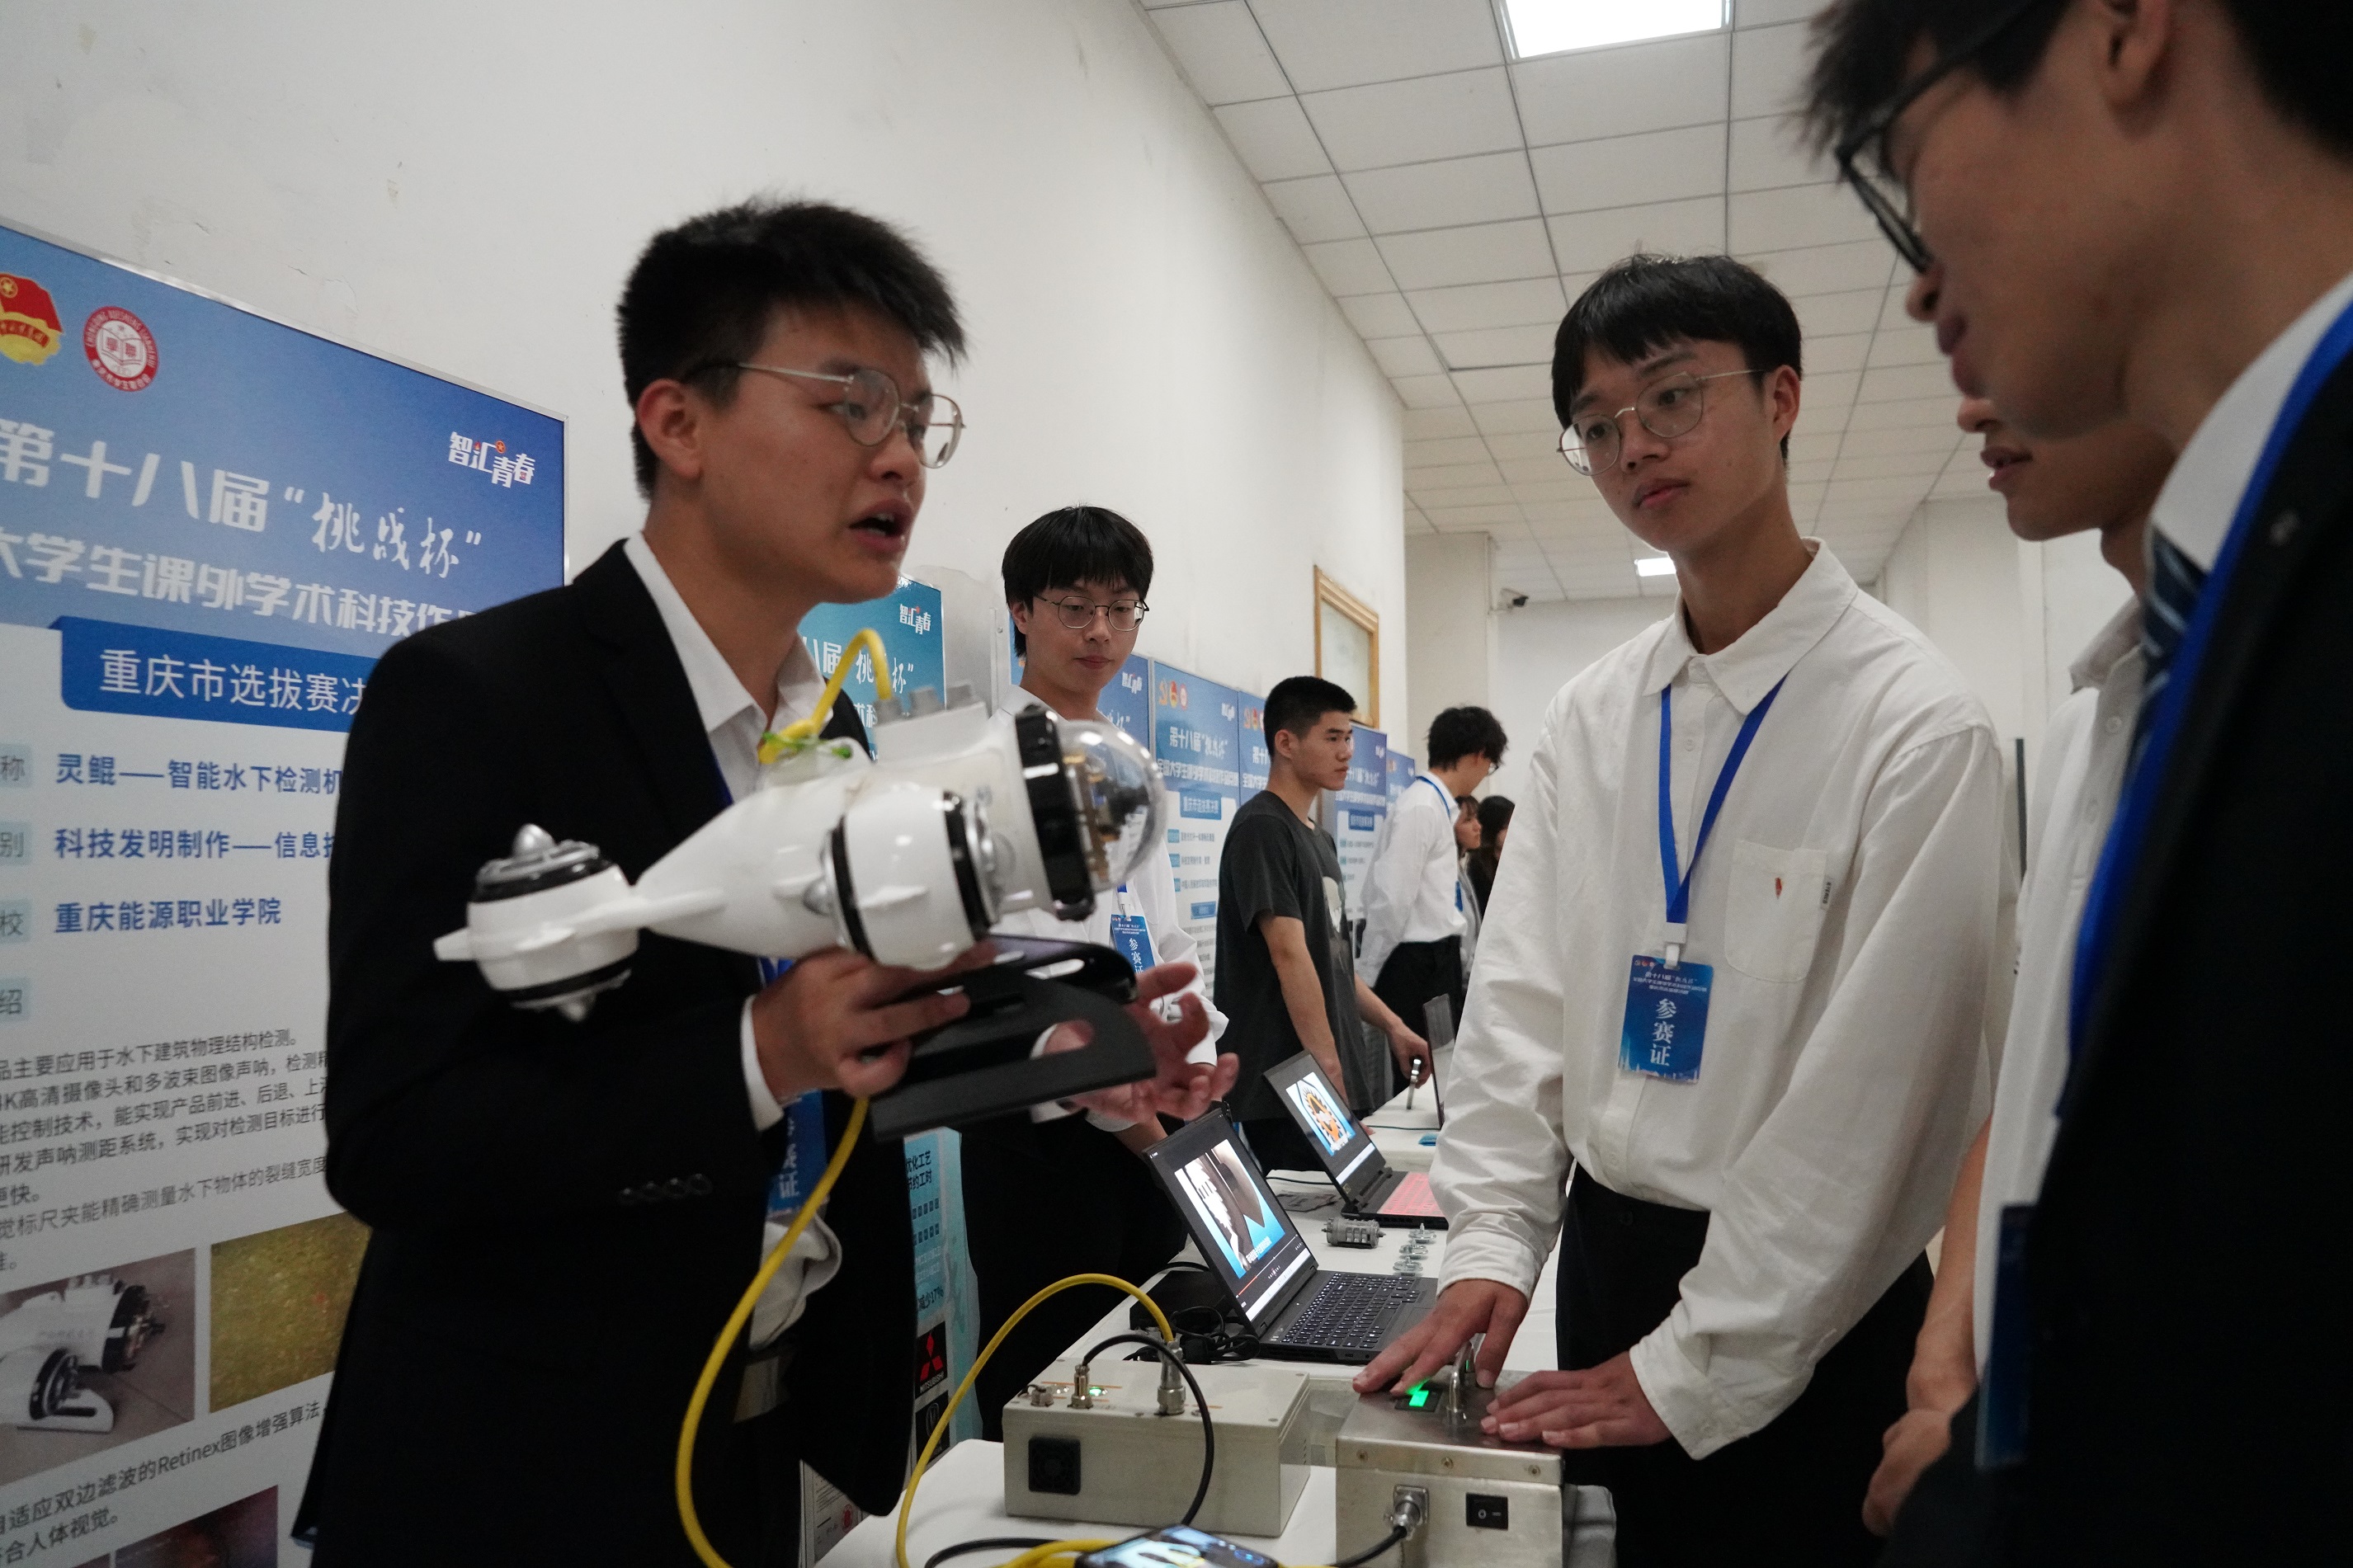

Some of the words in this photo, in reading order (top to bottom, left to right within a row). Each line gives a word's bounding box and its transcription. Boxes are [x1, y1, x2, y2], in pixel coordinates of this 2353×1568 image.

[449, 431, 536, 488] 智汇青春
[899, 603, 931, 635] 智汇青春
[54, 897, 282, 934] 重庆能源职业学院
[1649, 998, 1677, 1067] 参赛证
